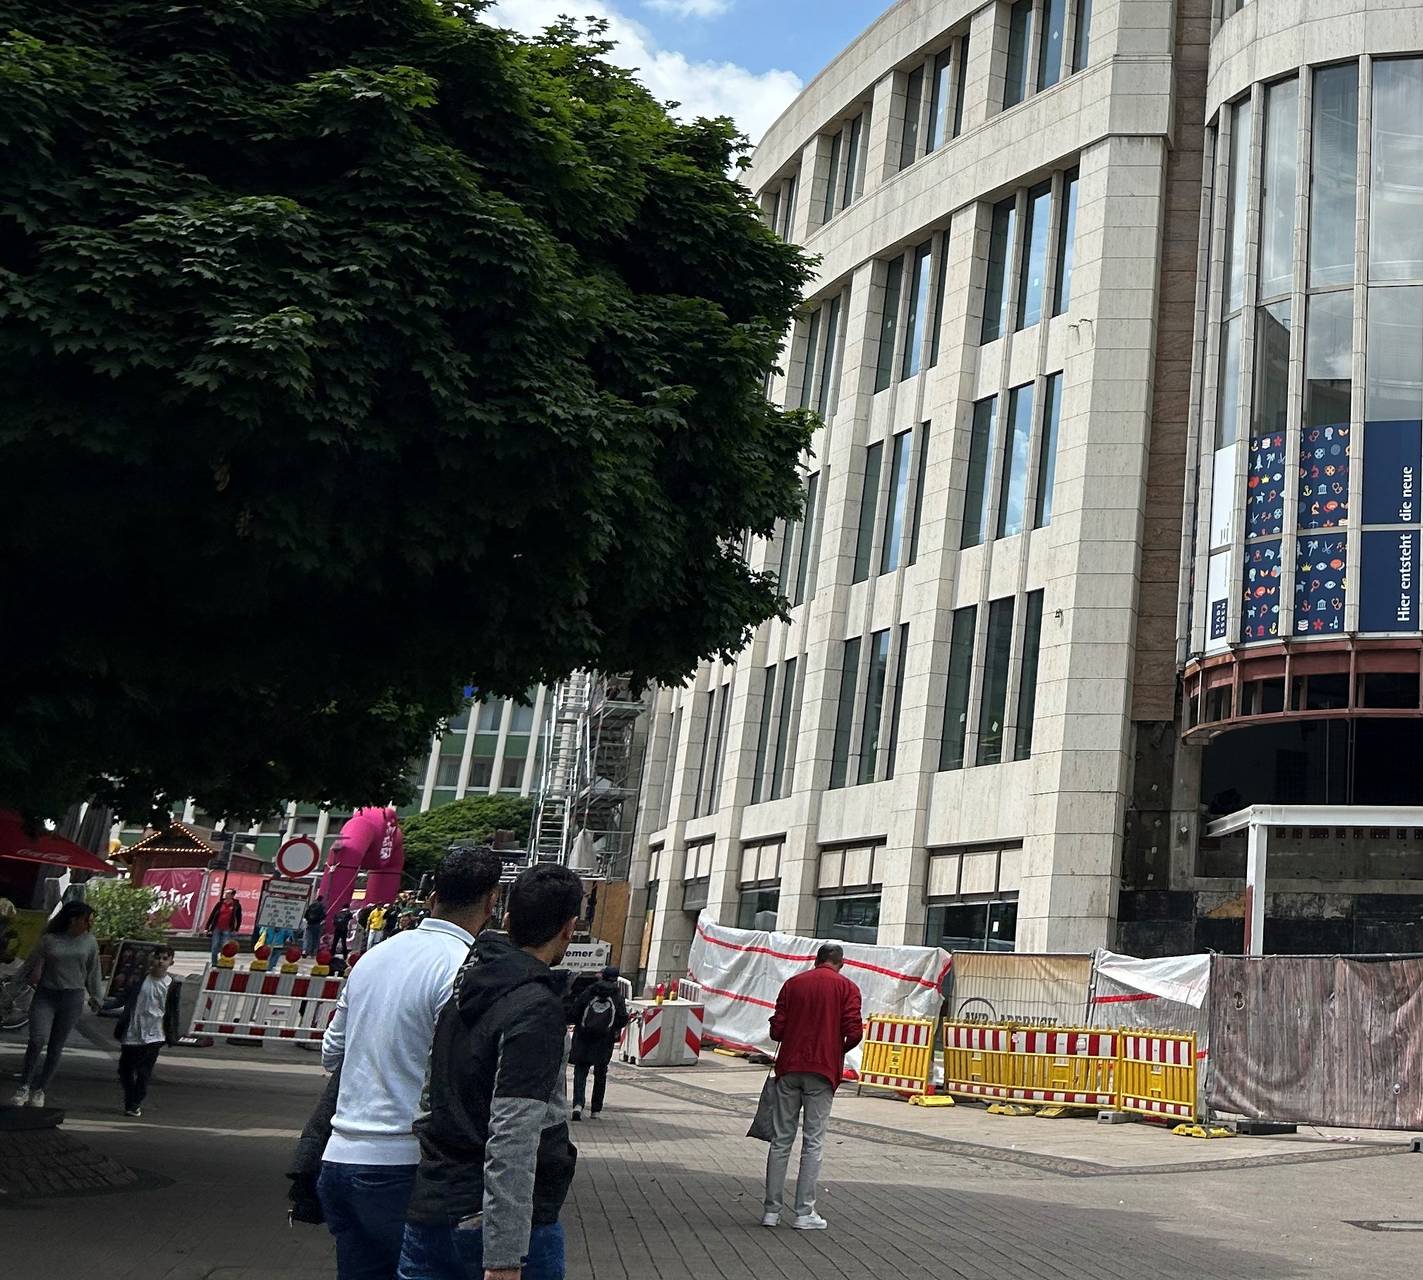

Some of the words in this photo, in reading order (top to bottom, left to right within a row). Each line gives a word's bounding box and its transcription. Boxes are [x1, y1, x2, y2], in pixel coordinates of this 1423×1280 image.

[1401, 466, 1413, 498] neue
[1399, 502, 1413, 522] die
[1398, 534, 1412, 590] entsteht
[1397, 593, 1411, 622] Hier
